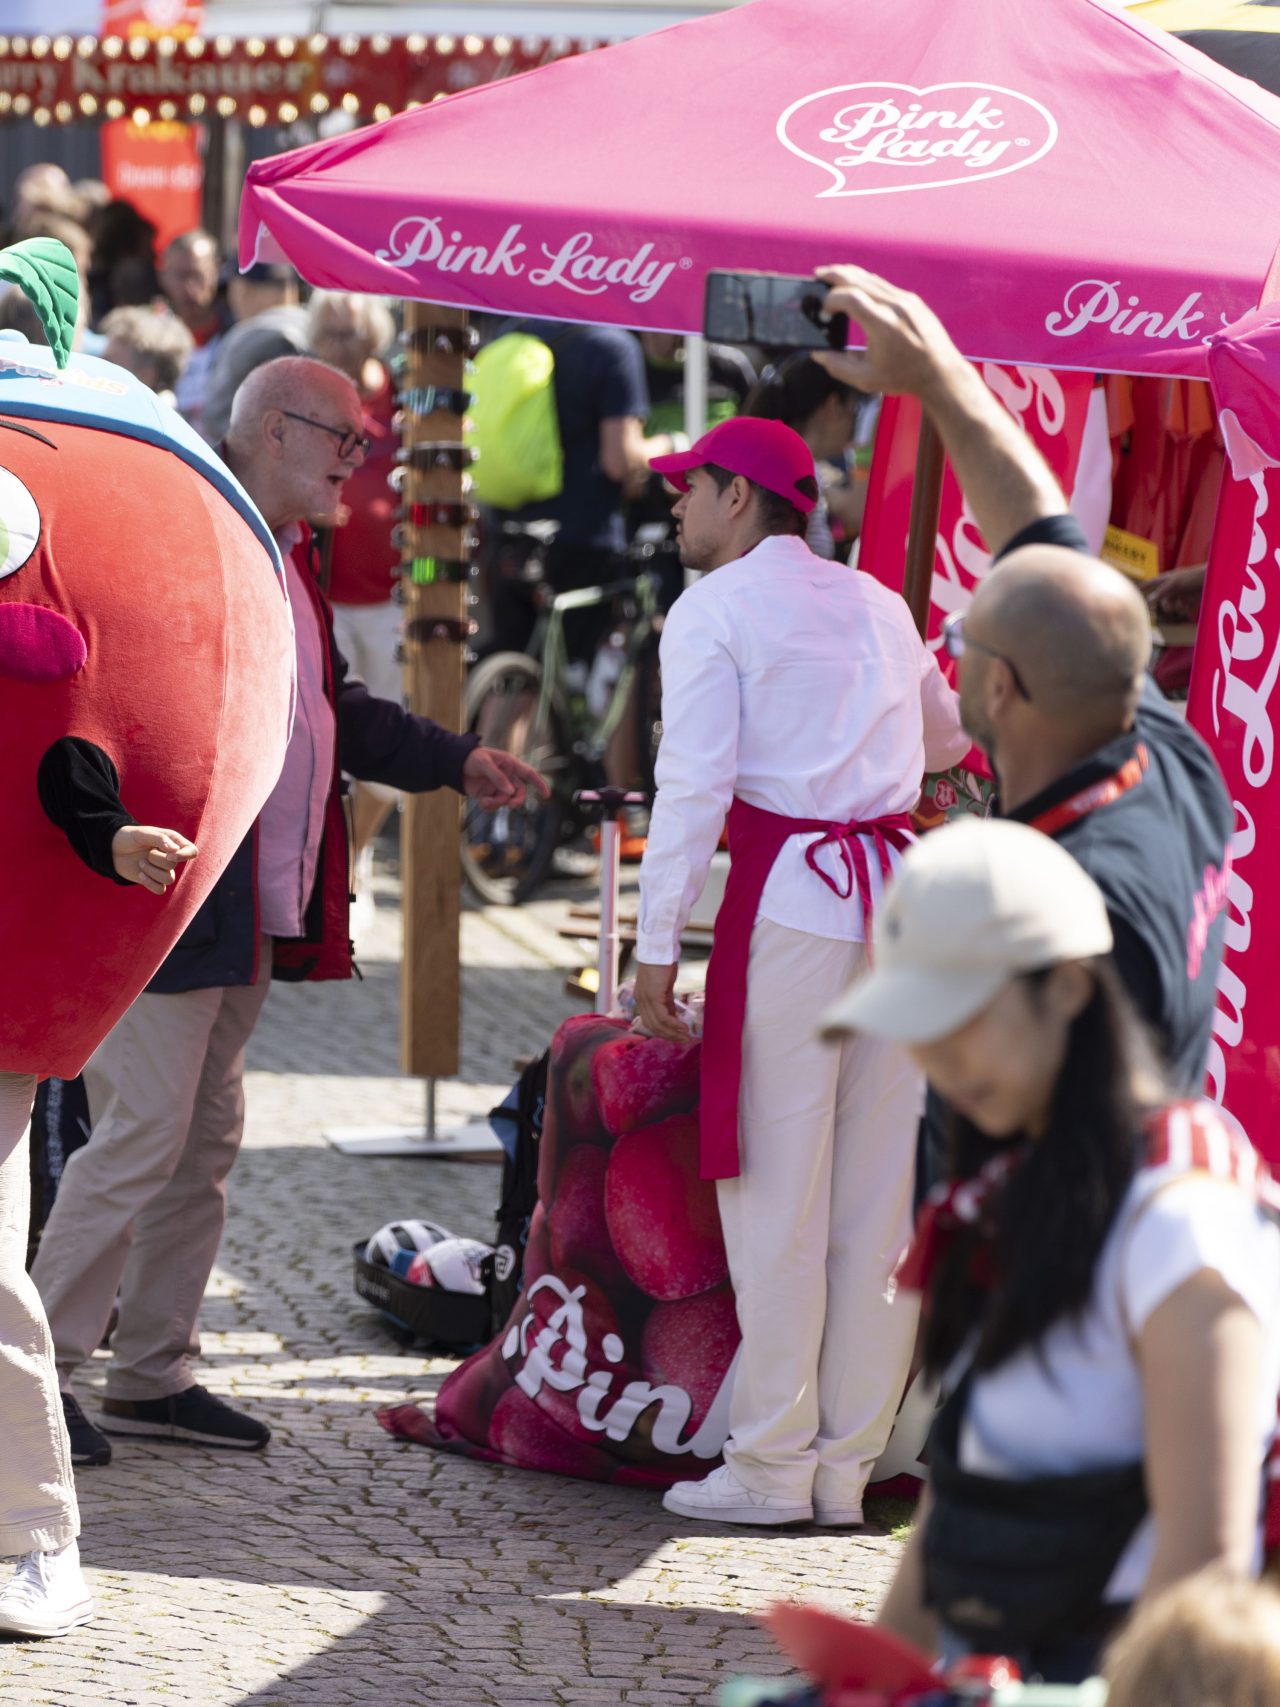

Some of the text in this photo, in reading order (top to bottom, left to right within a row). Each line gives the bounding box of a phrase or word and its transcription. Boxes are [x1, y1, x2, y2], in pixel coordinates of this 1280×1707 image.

[819, 97, 1005, 143] Pink
[375, 216, 527, 277] Pink
[1044, 279, 1205, 340] Pink
